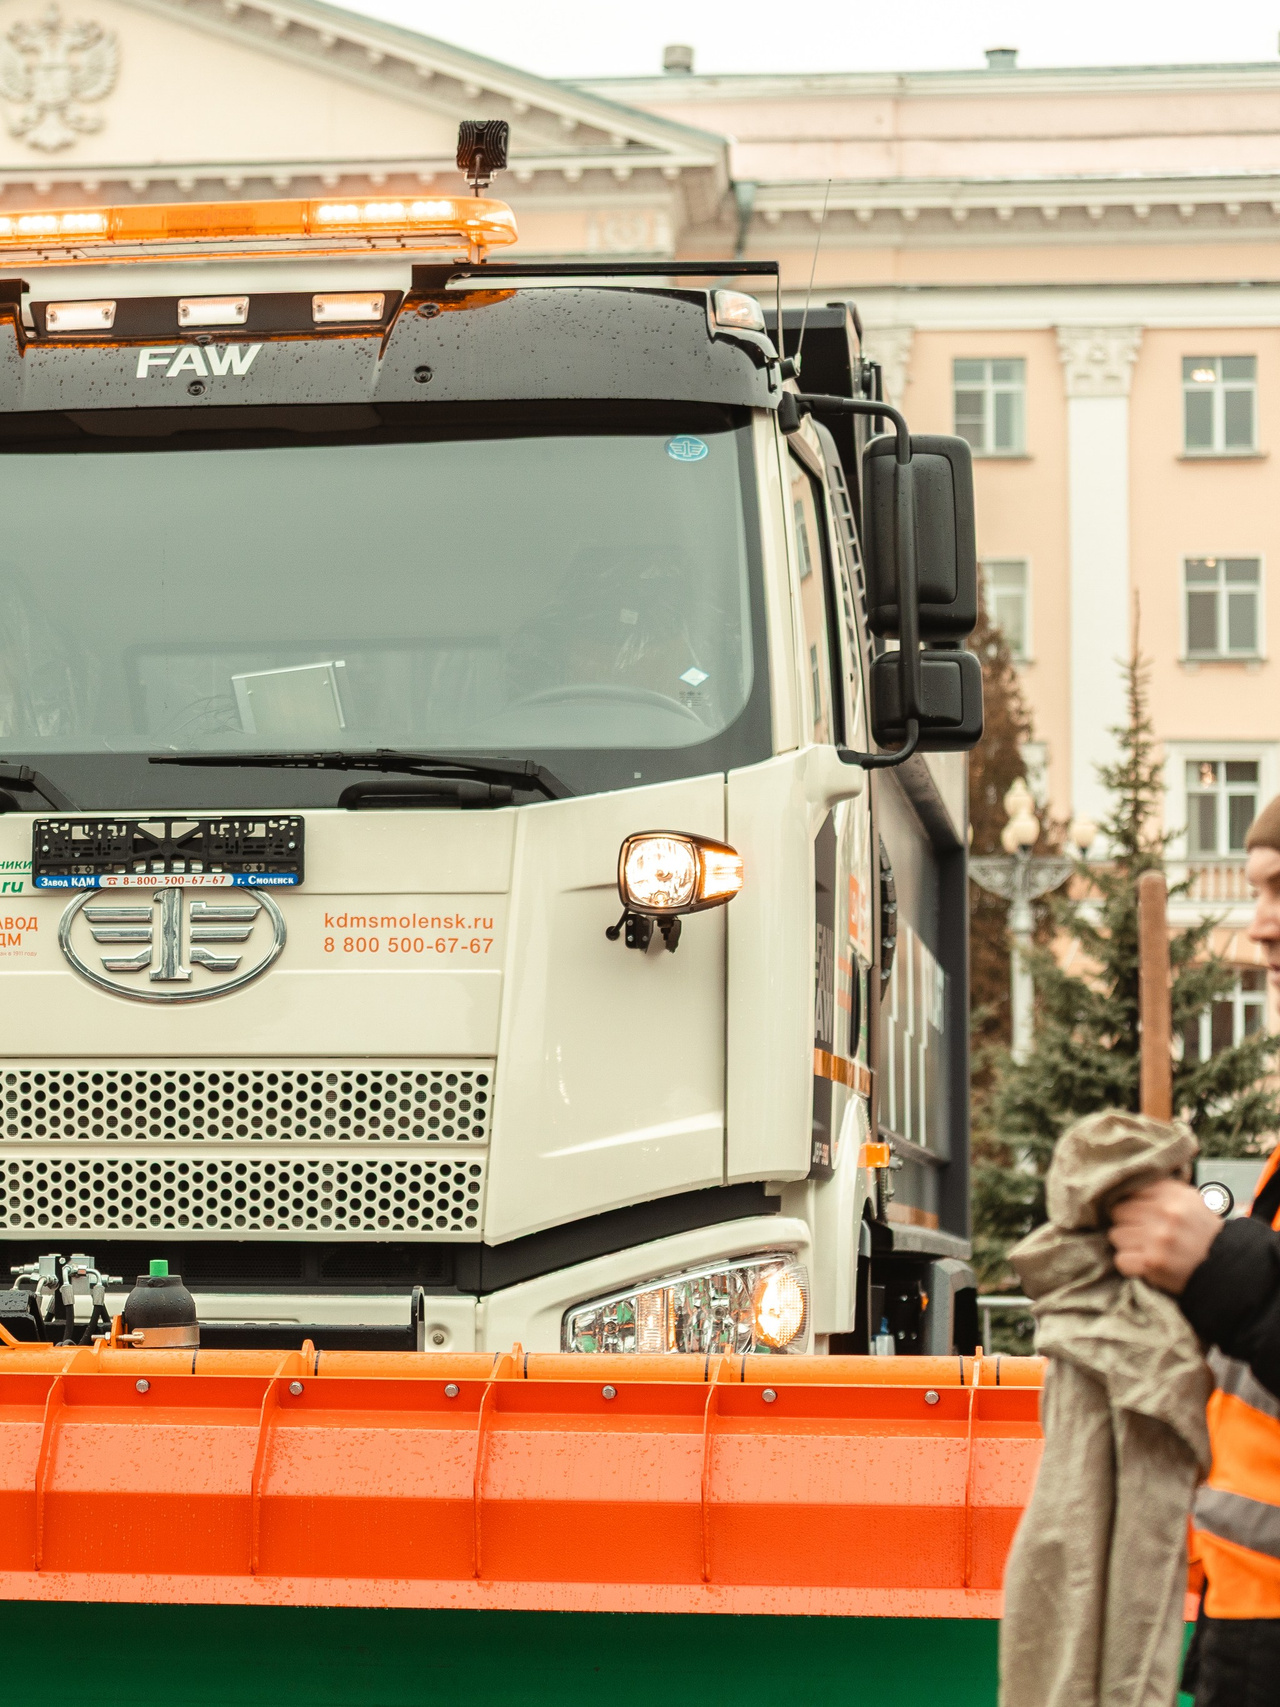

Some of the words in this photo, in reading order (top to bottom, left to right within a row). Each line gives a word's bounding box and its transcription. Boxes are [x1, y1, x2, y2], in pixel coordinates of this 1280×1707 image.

[136, 343, 263, 379] FAW
[71, 877, 95, 887] КДМ
[123, 876, 225, 885] 8-800-500-67-67
[324, 913, 493, 929] kdmsmolensk.ru
[324, 937, 335, 953] 8
[343, 937, 379, 953] 800
[388, 938, 494, 954] 500-67-67
